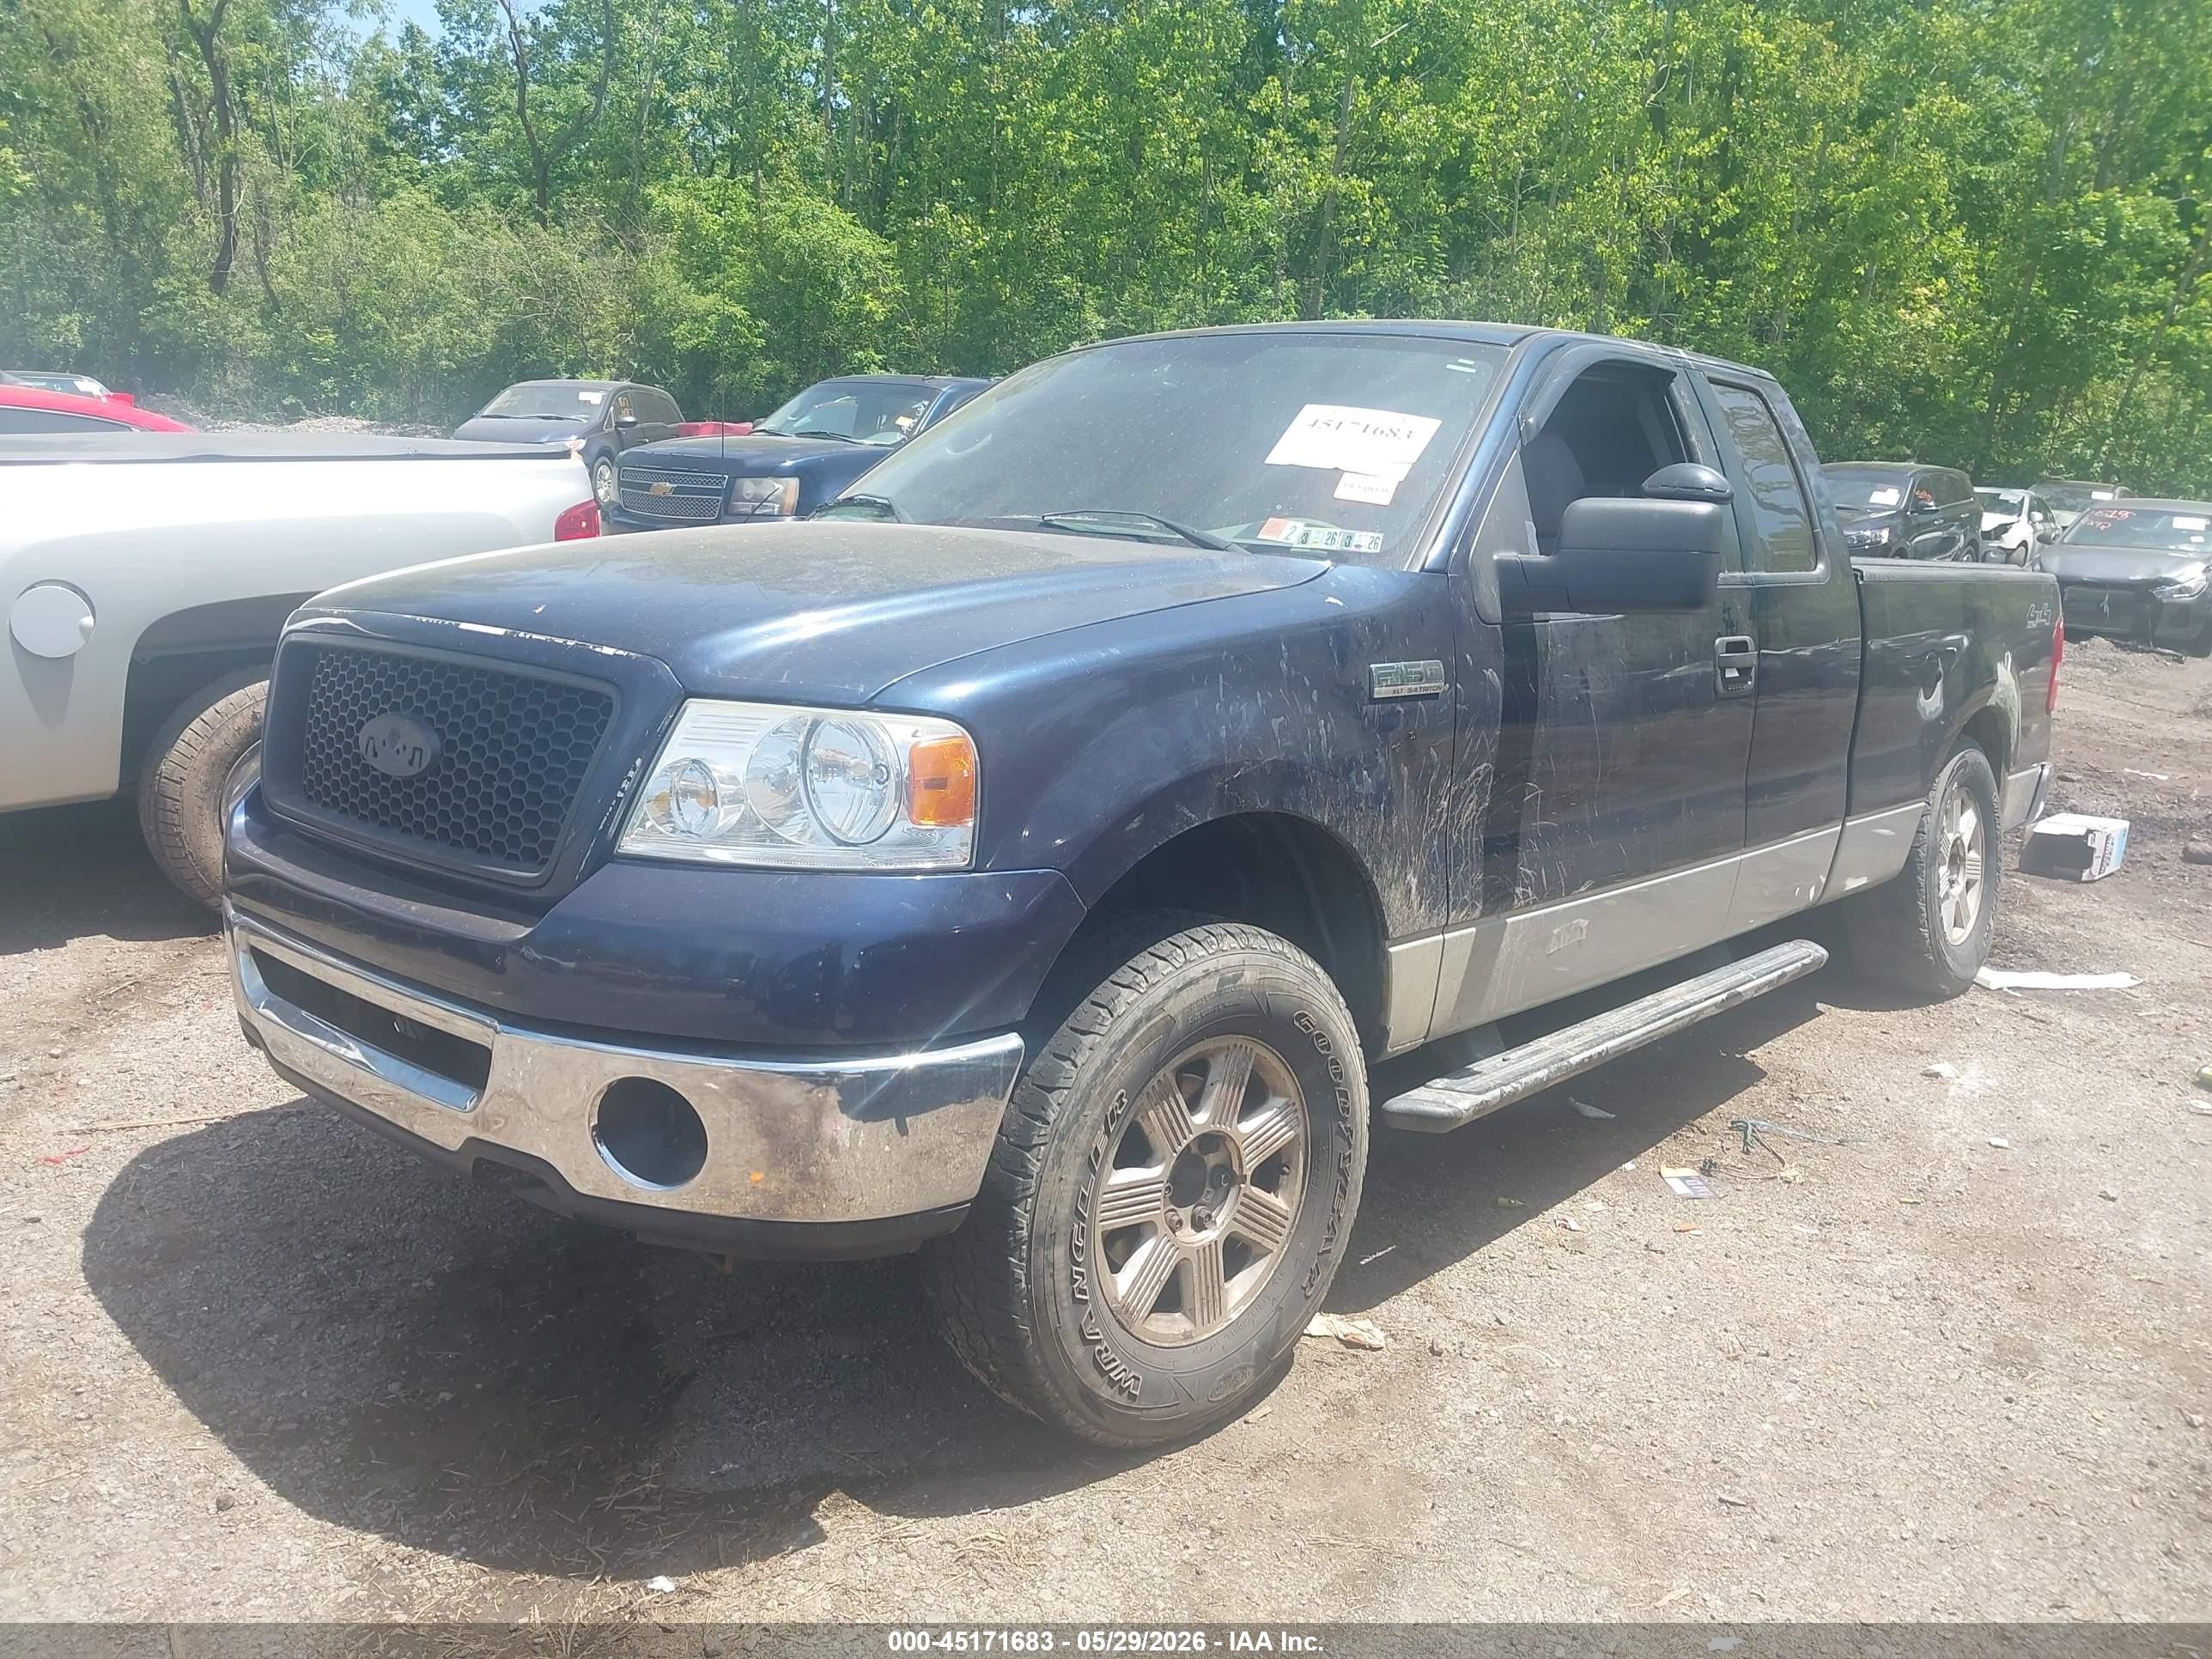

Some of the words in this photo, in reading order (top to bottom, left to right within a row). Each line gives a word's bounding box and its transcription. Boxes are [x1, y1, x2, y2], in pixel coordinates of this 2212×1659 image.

[1300, 532, 1309, 544] 3
[1325, 532, 1338, 547] 26
[1344, 535, 1352, 548] 3
[1367, 535, 1379, 550] 26
[1293, 1009, 1354, 1299] GOODYEAR
[1070, 1089, 1142, 1397] WRANGLER
